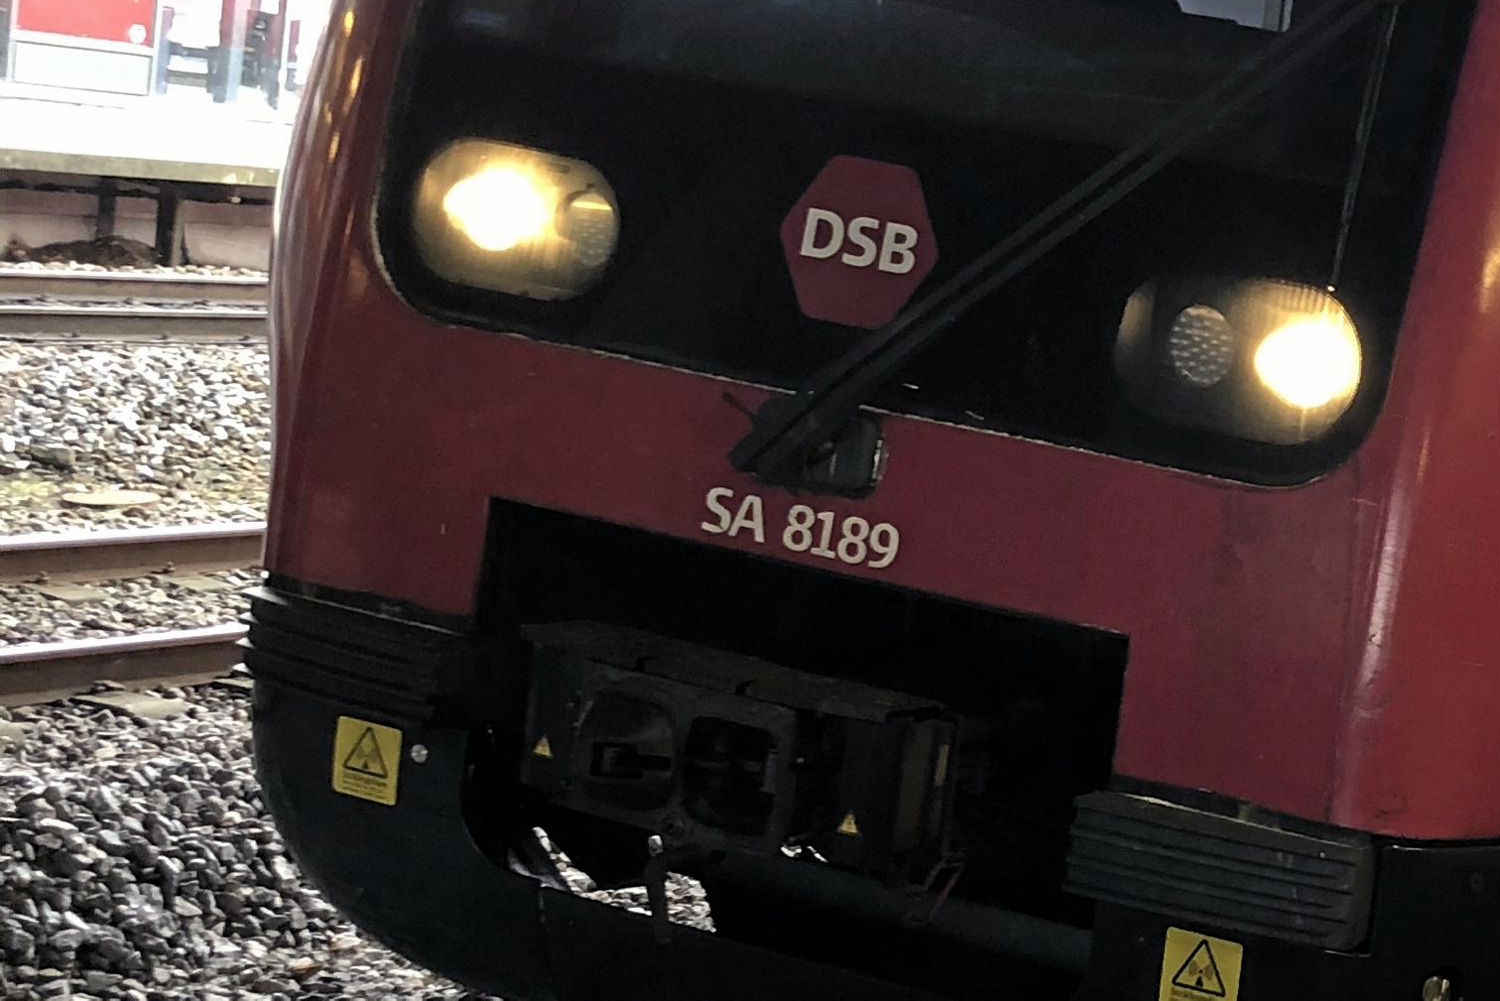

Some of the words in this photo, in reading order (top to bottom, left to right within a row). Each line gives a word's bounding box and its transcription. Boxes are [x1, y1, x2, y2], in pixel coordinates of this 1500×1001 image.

[800, 206, 920, 275] DSB
[700, 486, 766, 544] SA
[782, 504, 900, 570] 8189
